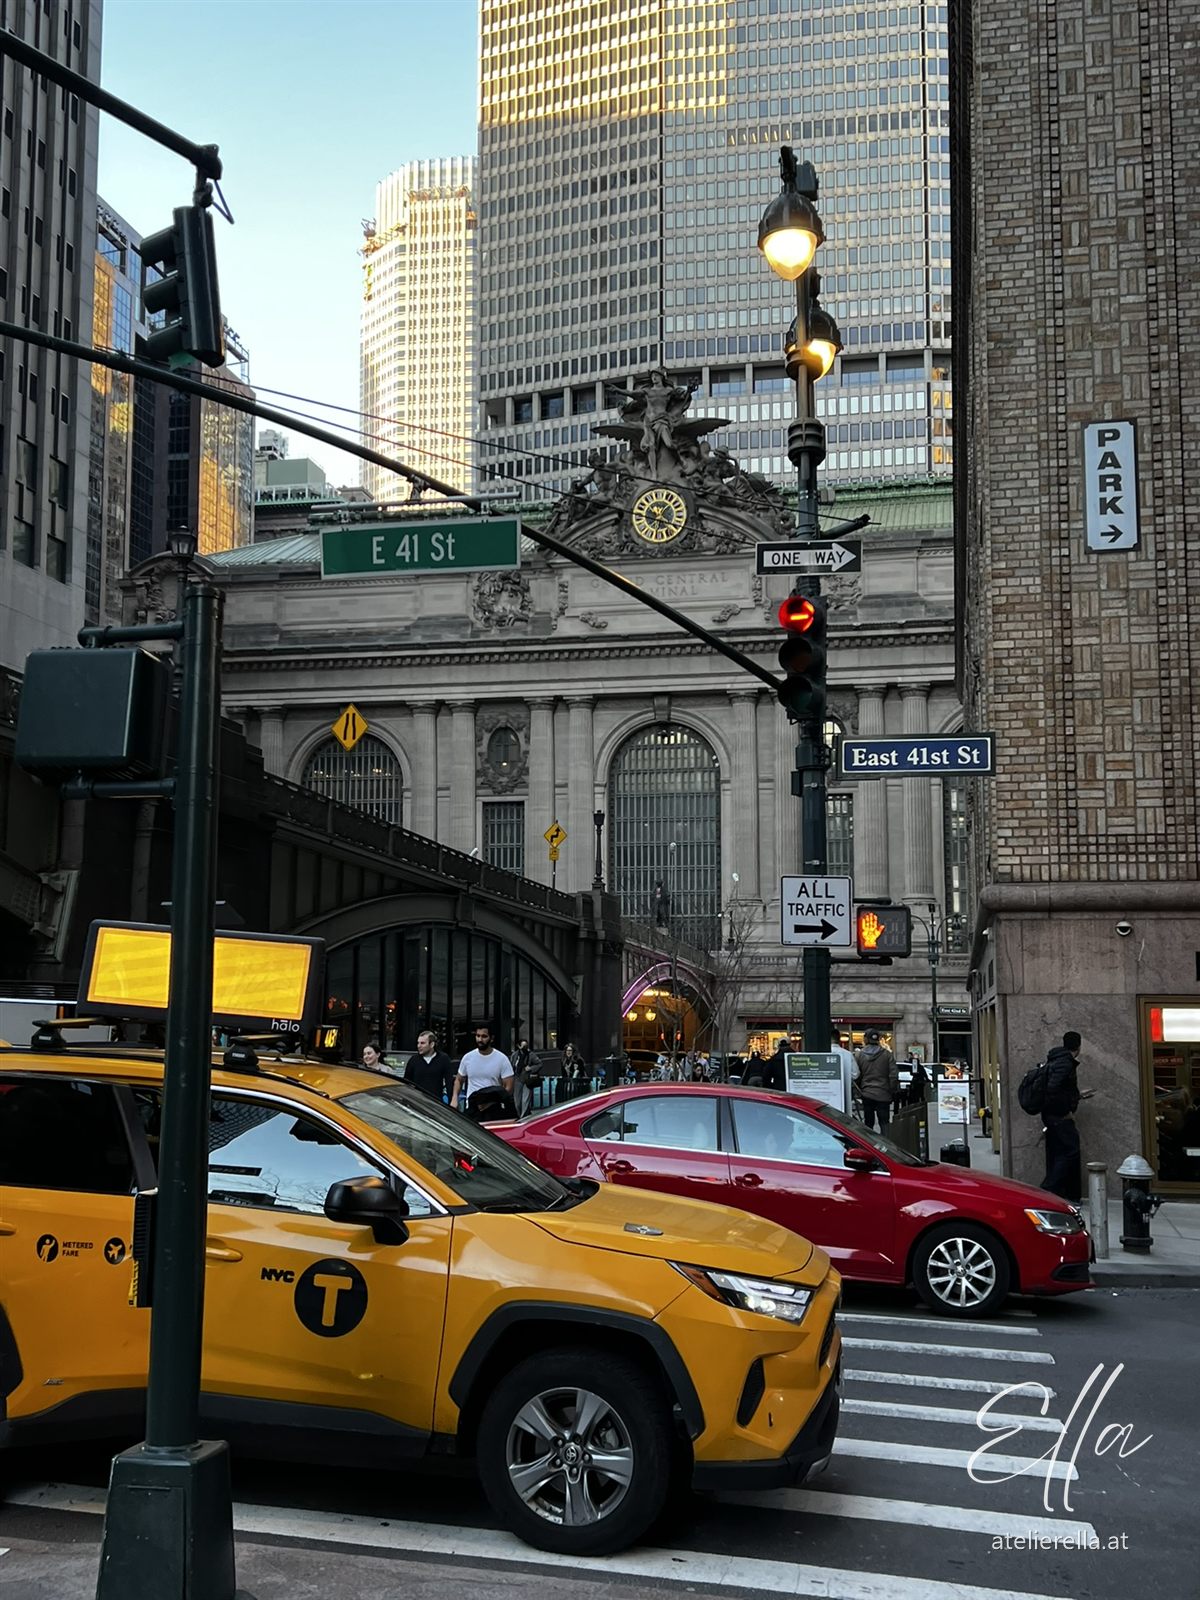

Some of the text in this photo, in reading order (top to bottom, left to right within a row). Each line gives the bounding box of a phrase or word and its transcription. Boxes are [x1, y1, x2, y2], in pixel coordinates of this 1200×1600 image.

[1097, 428, 1125, 515] PARK
[372, 532, 456, 564] E 41 St
[771, 551, 846, 565] ONE WAY
[656, 572, 728, 585] CENTRAL
[852, 746, 981, 767] East 41st St
[797, 882, 836, 898] ALL
[787, 903, 846, 917] TRAFFIC
[62, 1241, 94, 1250] METERED
[62, 1250, 80, 1258] FARE
[261, 1267, 295, 1283] NYC
[313, 1273, 353, 1327] T
